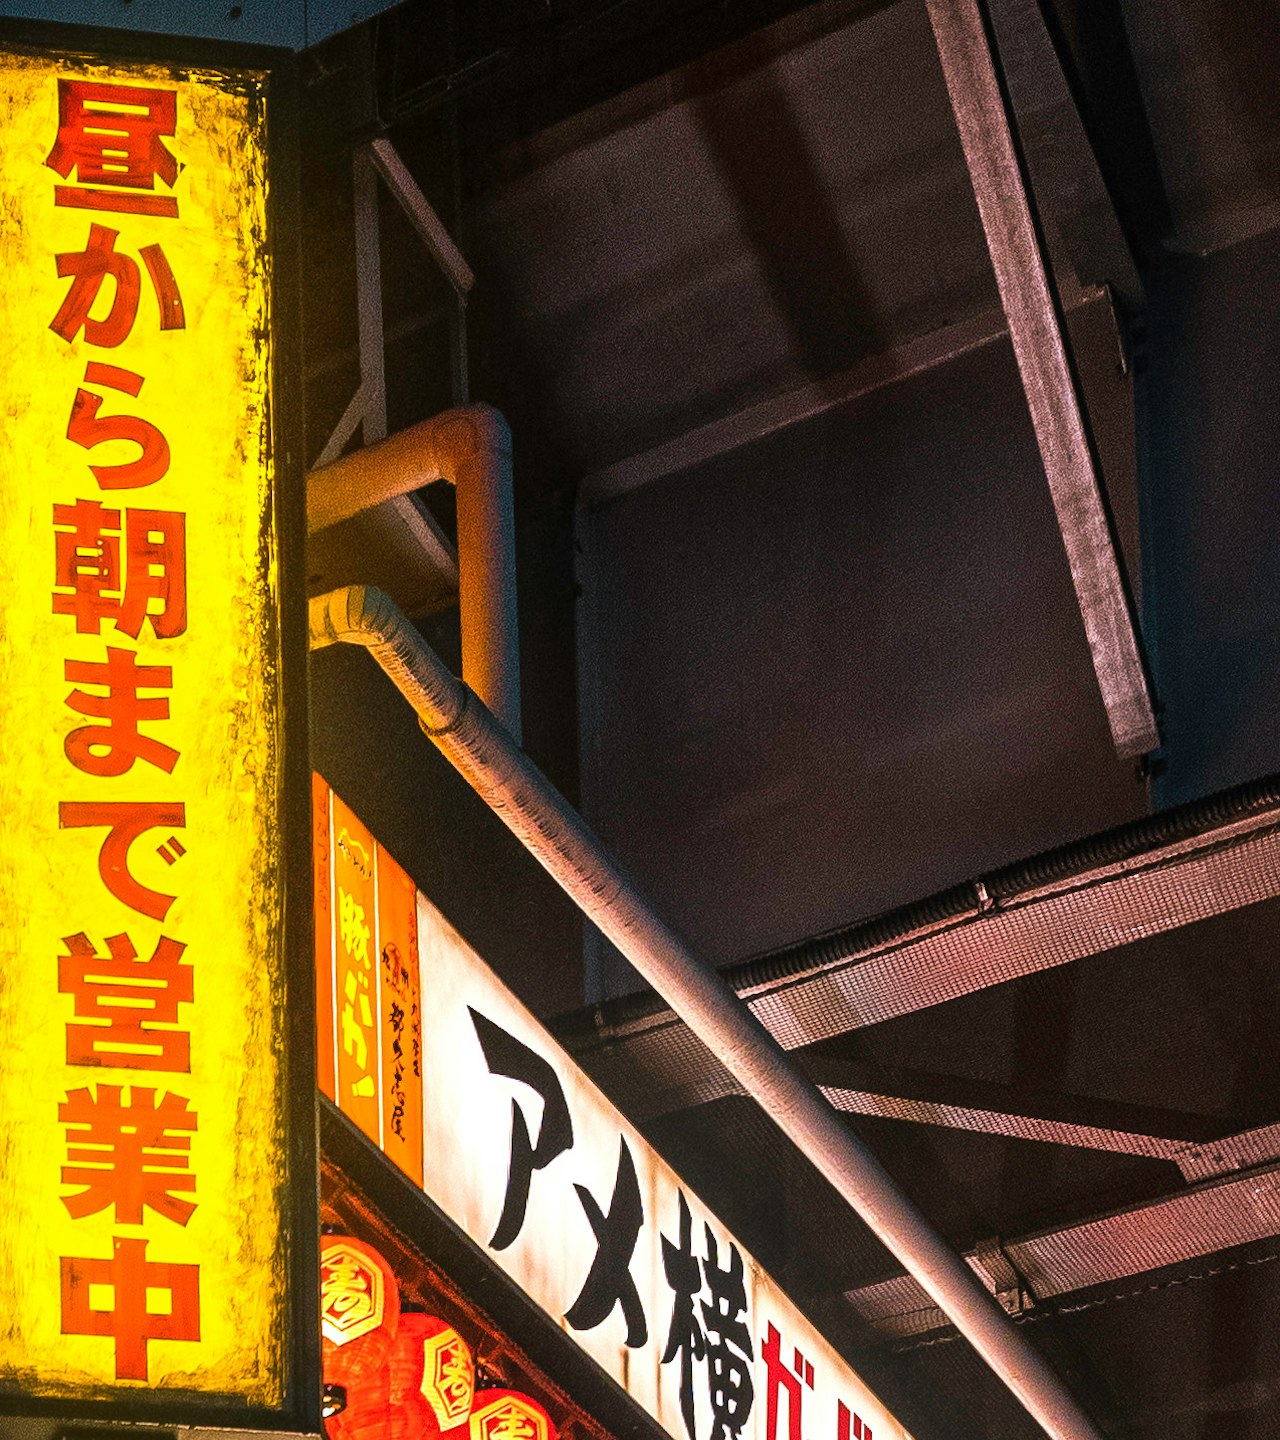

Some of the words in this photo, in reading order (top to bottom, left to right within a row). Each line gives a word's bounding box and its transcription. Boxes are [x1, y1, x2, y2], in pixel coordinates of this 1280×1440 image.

[47, 76, 198, 1384] 昼から朝まで営業中
